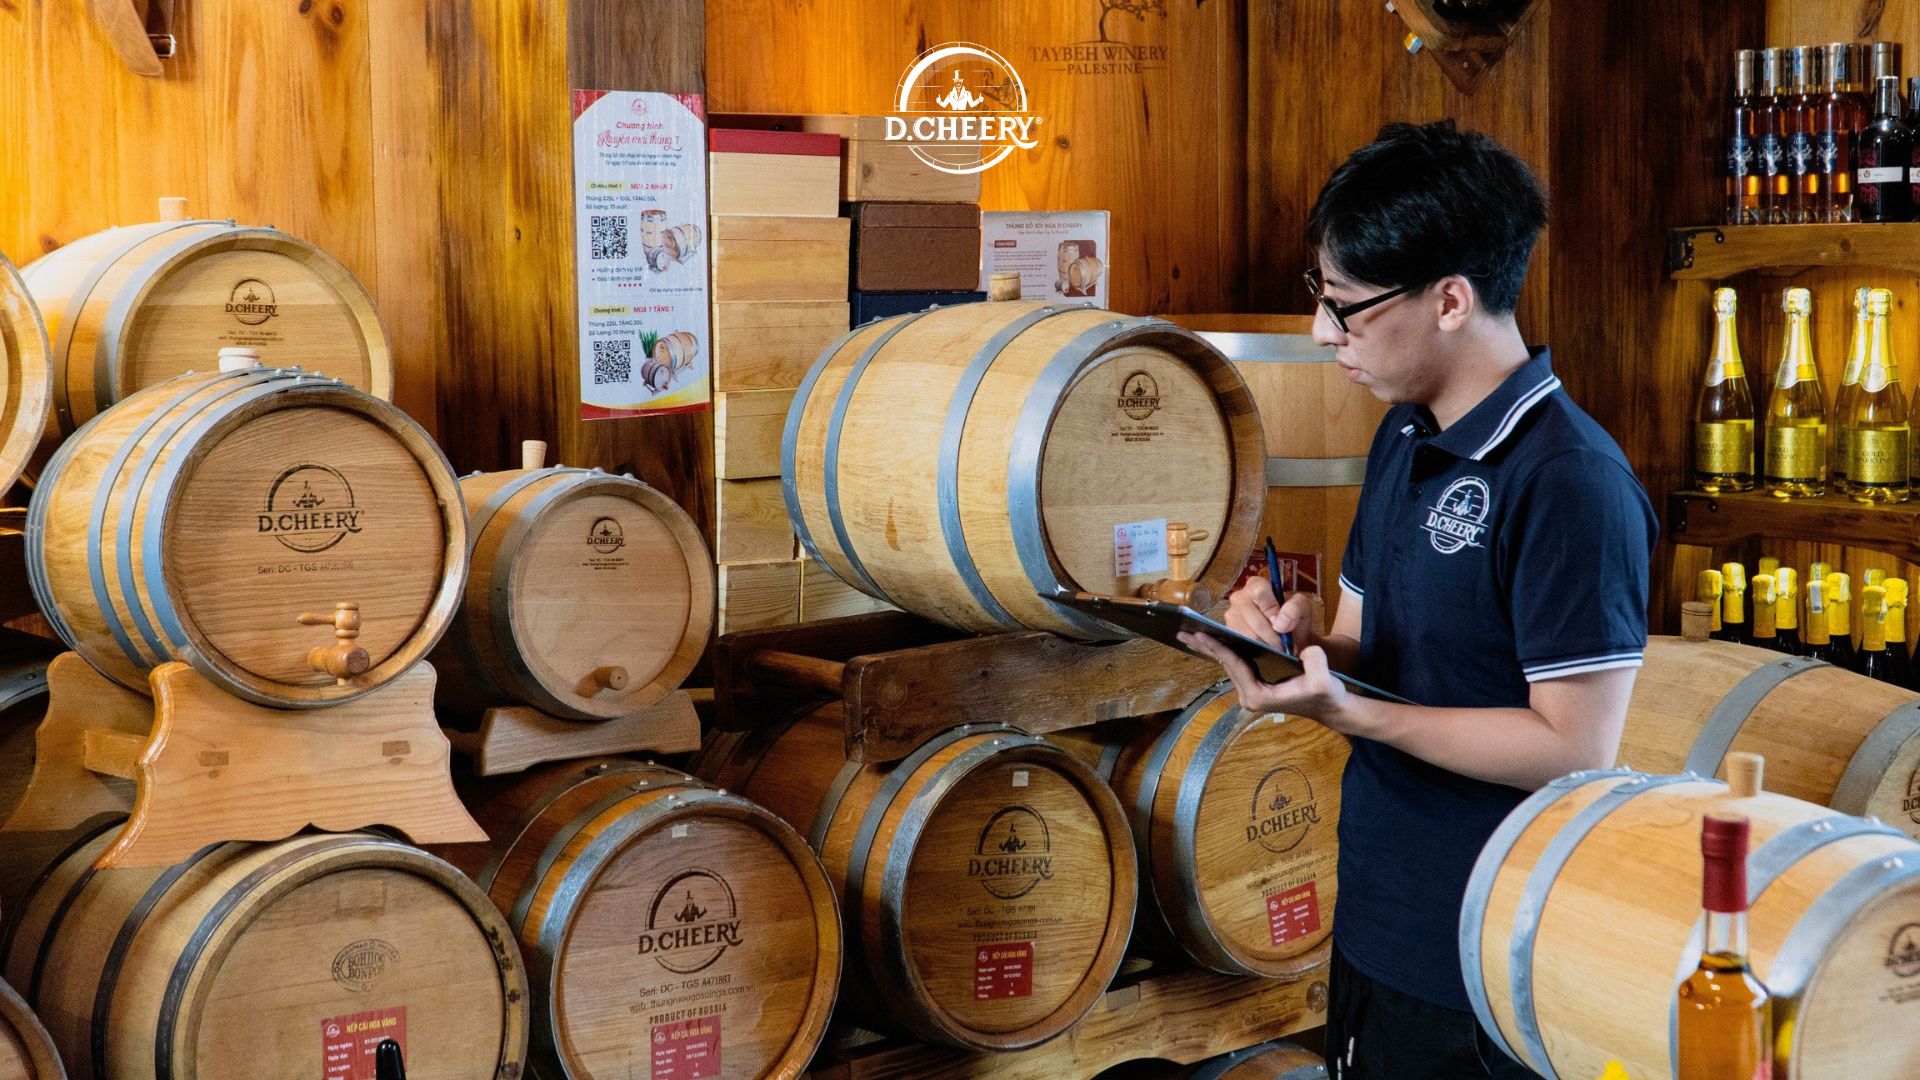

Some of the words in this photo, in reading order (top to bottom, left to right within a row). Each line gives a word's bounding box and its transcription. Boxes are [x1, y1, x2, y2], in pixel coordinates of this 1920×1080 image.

[1029, 46, 1098, 61] TAYBEH
[1103, 45, 1168, 60] WINERY
[1067, 62, 1143, 75] PALESTINE
[225, 303, 279, 317] D.CHEERY
[1117, 398, 1161, 410] D.CHEERY
[258, 510, 362, 534] D.CHEERY
[1426, 511, 1480, 546] D.CHEERY
[587, 537, 626, 546] D.CHEERY
[278, 565, 292, 574] DC
[300, 563, 317, 572] TGS
[1246, 802, 1322, 842] D.CHEERY
[968, 856, 1054, 880] D.CHEERY
[638, 920, 744, 954] D.CHEERY
[660, 984, 674, 994] DC
[682, 980, 699, 990] TGS
[649, 1010, 685, 1024] PRODUCT
[688, 1008, 697, 1018] OF
[699, 1003, 728, 1016] RUSSIA
